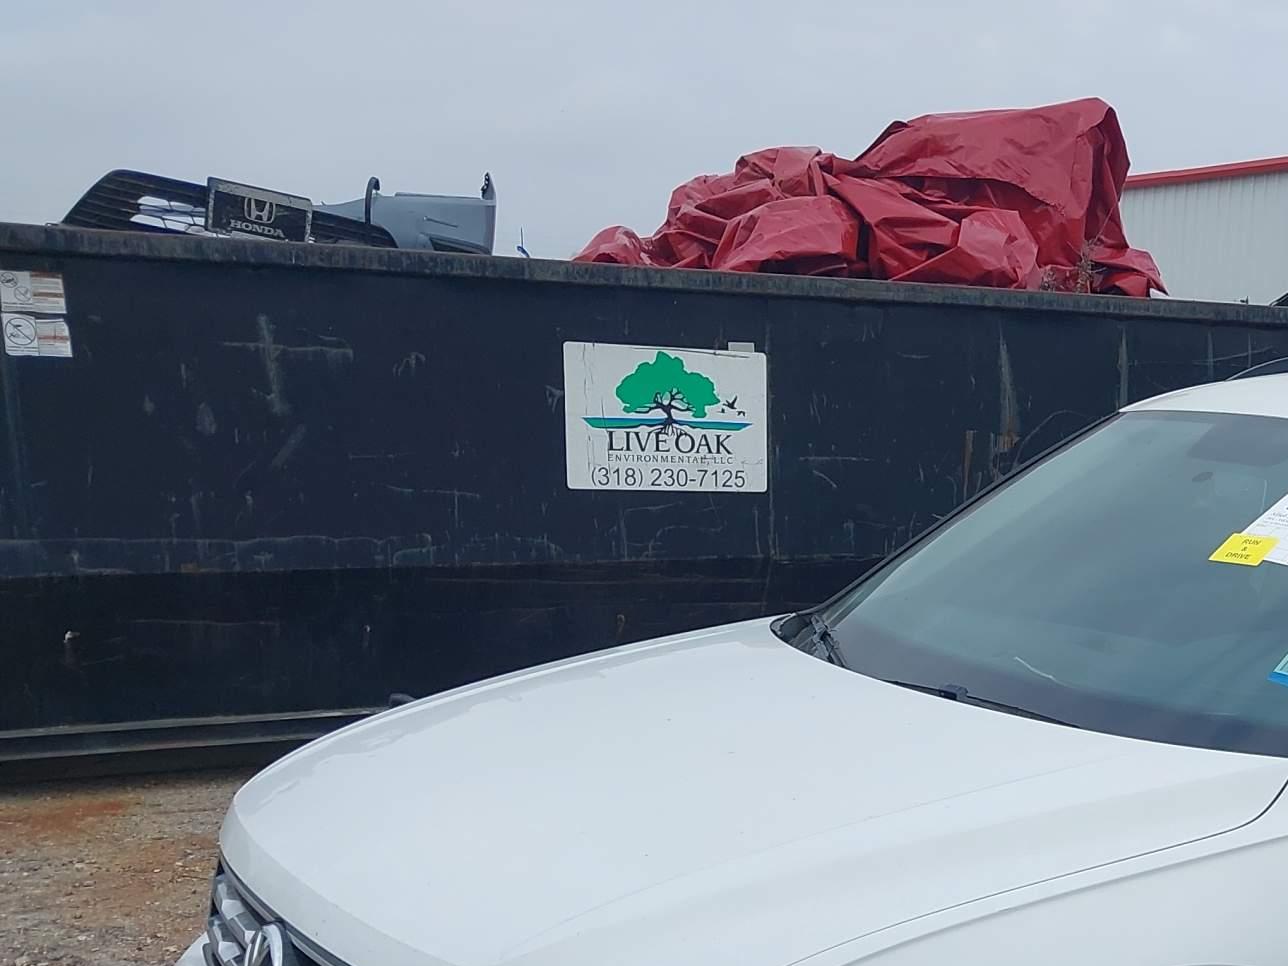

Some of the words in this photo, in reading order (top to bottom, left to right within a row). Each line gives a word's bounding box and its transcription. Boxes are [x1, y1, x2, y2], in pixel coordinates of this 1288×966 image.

[229, 219, 286, 238] HONDA
[607, 430, 670, 452] LIVE
[674, 431, 733, 454] OAK
[713, 456, 734, 464] LLC
[591, 467, 643, 487] (318)
[650, 468, 745, 488] 230-7125
[1241, 538, 1262, 546] RUN
[1224, 551, 1252, 560] DRIVE
